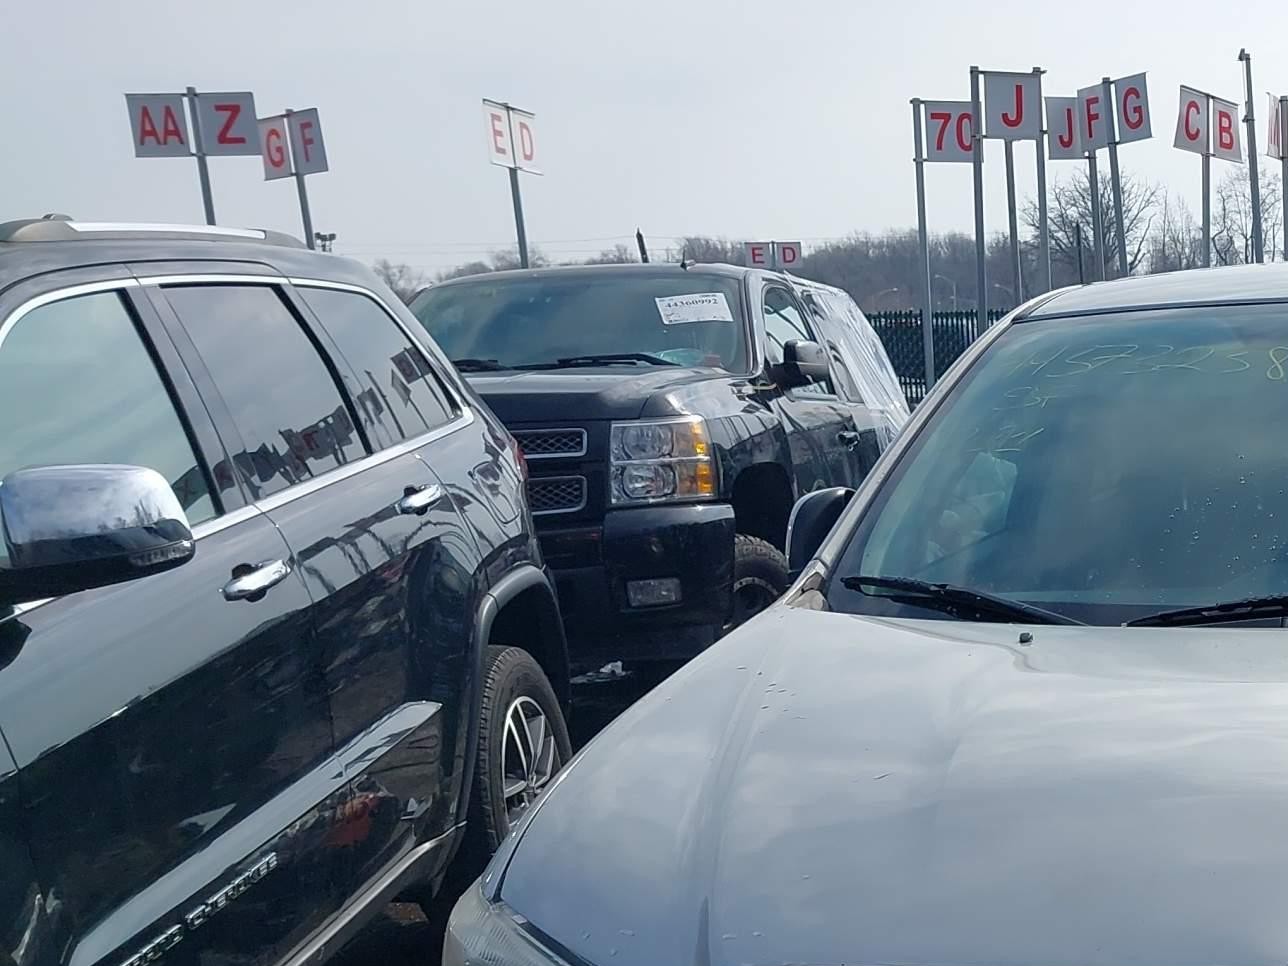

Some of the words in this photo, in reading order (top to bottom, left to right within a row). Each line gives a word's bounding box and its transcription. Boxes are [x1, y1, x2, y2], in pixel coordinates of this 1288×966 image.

[139, 105, 184, 145] AA
[214, 104, 246, 144] Z
[1001, 84, 1024, 128] J
[1085, 96, 1100, 138] F
[1122, 87, 1144, 129] G
[1184, 100, 1201, 141] C
[1218, 111, 1234, 150] B
[265, 128, 285, 168] G
[300, 121, 314, 162] F
[490, 113, 507, 155] E
[520, 122, 534, 161] D
[929, 112, 973, 152] 70
[1058, 108, 1074, 149] J
[751, 246, 765, 264] E
[782, 246, 796, 263] D
